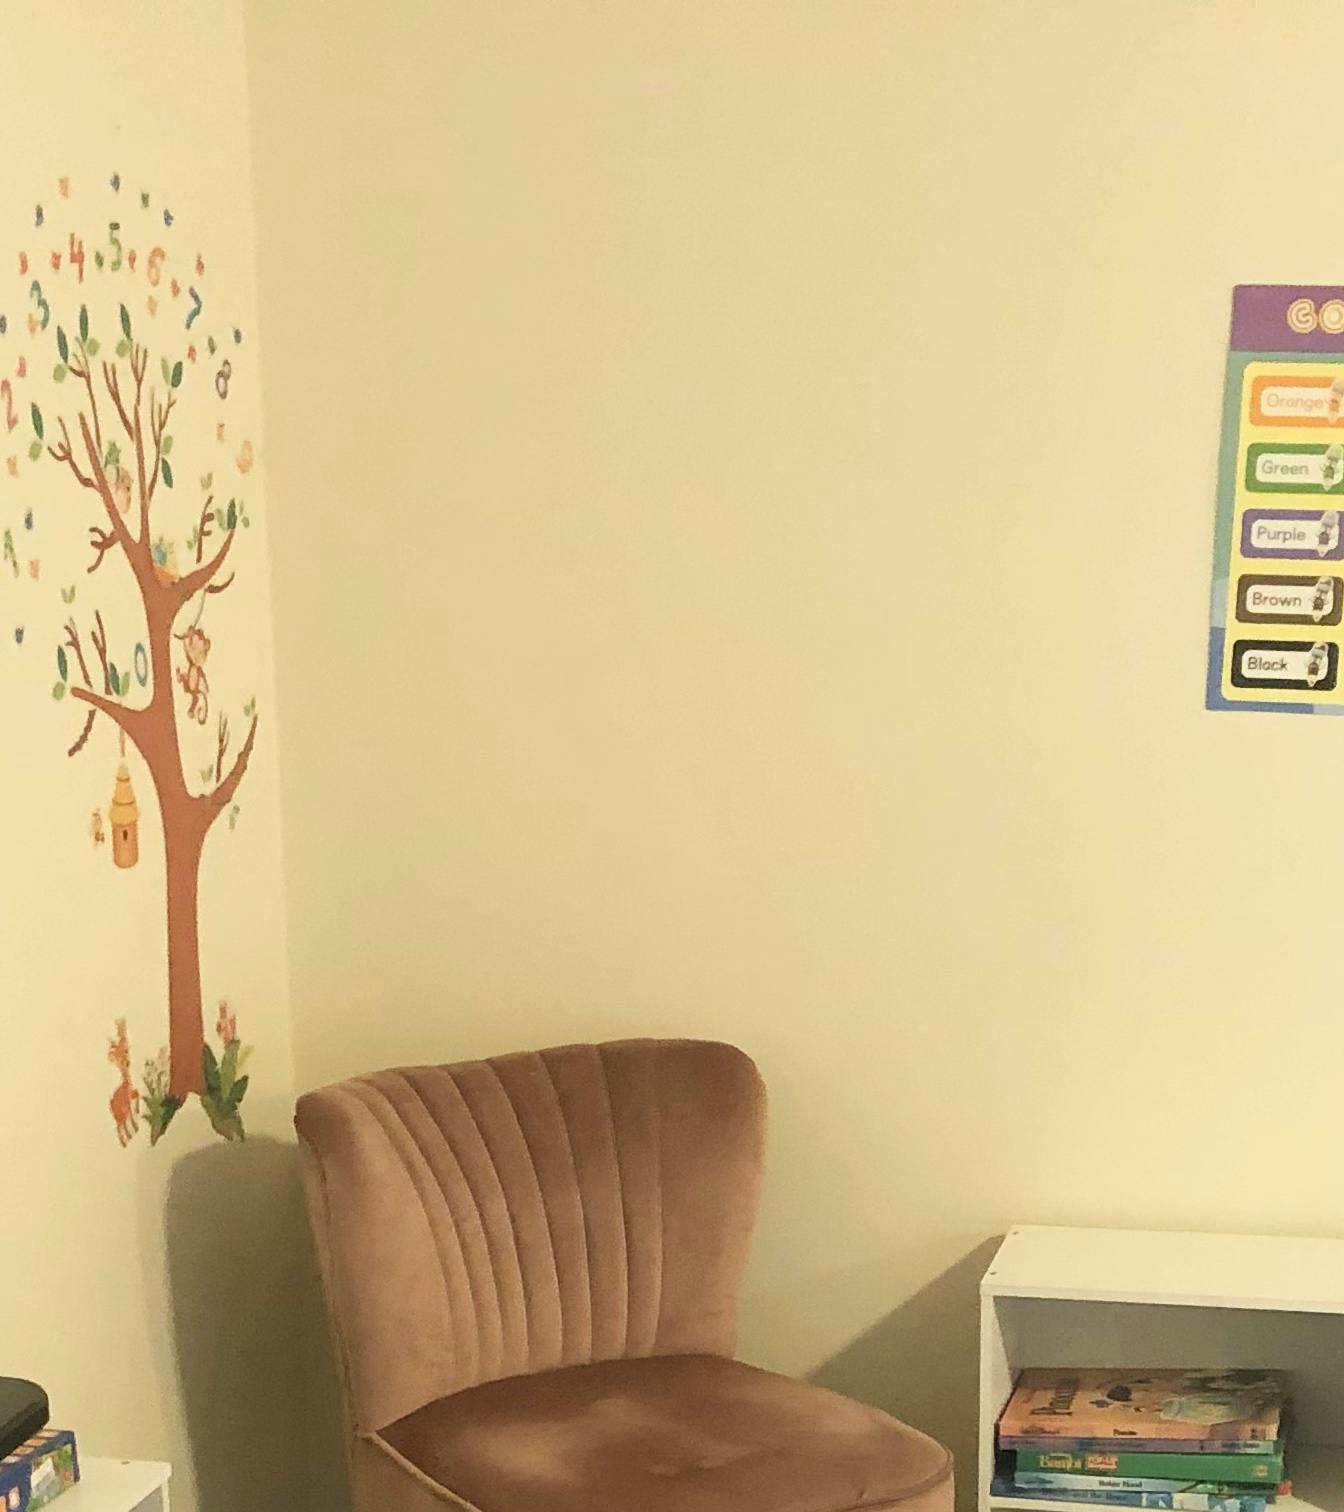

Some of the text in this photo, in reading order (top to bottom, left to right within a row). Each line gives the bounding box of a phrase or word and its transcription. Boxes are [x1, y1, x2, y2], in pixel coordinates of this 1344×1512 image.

[109, 222, 122, 271] 5
[69, 232, 84, 283] 4
[1266, 393, 1324, 412] Orange
[1261, 461, 1309, 476] Green
[1256, 527, 1306, 546] Purple
[1252, 593, 1302, 607] Brown
[1247, 657, 1288, 672] Black
